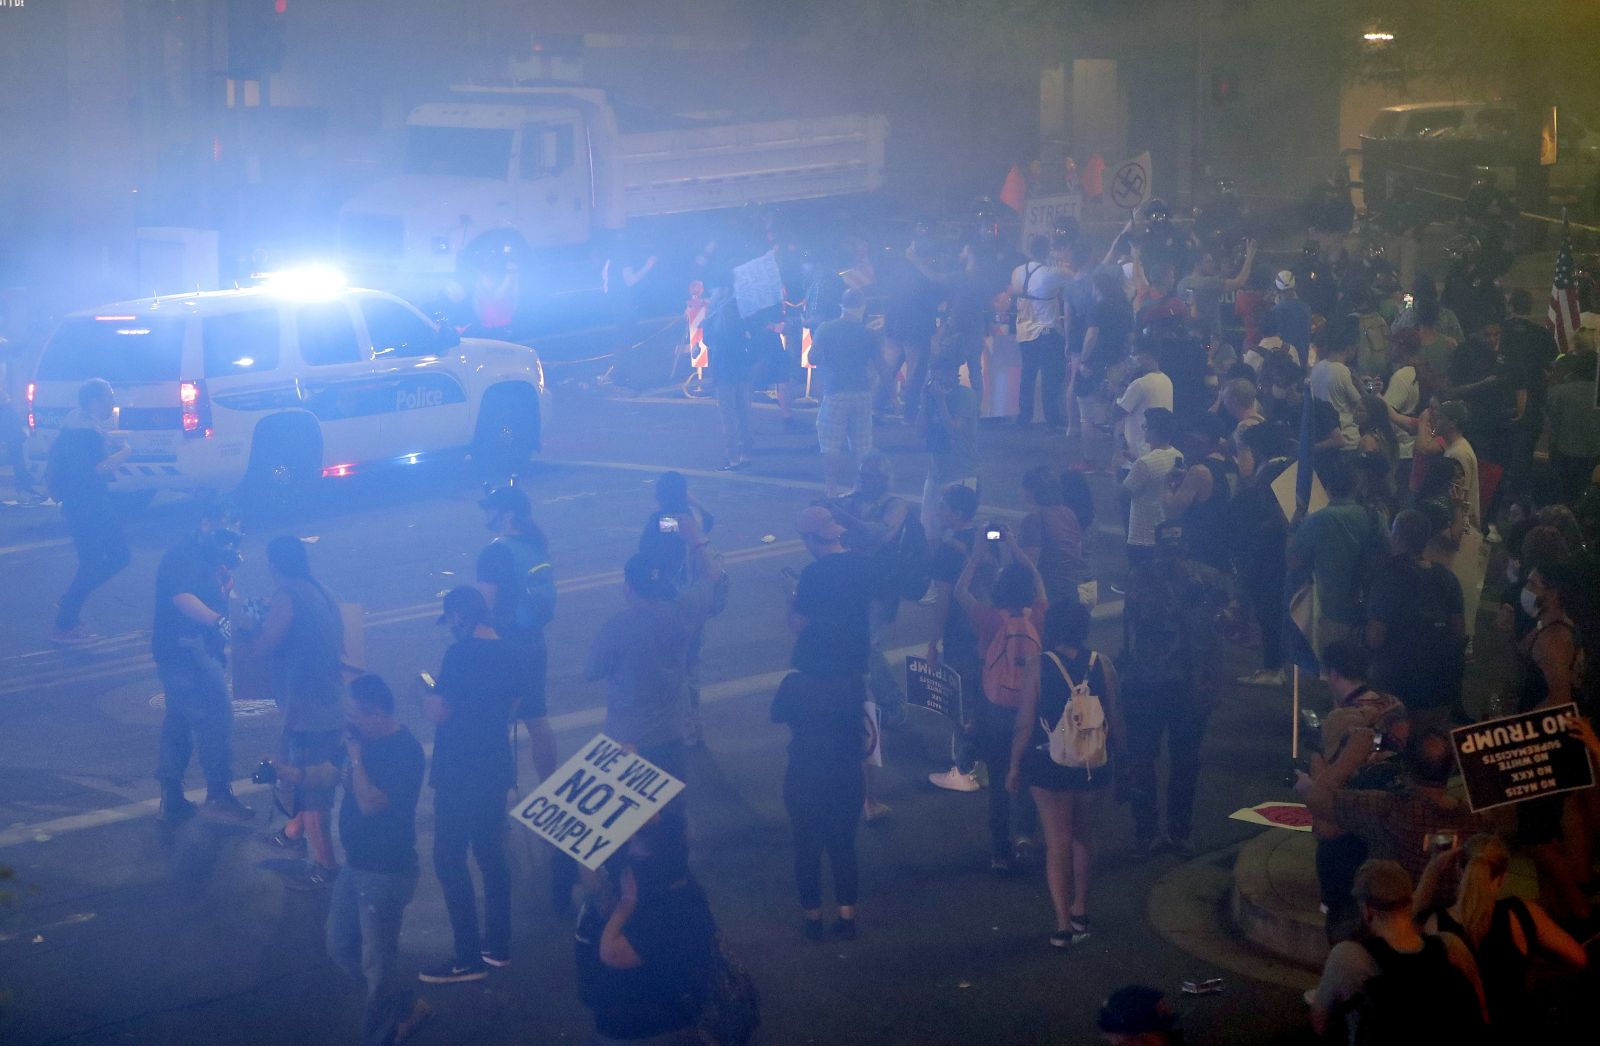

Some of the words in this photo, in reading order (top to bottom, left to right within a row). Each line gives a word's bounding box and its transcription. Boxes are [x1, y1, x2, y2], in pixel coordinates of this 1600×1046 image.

[396, 386, 443, 410] Police
[1541, 711, 1574, 735] NO
[1461, 720, 1540, 754] TRUMP
[1481, 739, 1562, 765] SUPREMACISTS
[1533, 752, 1549, 763] NO
[584, 739, 627, 773] WE
[617, 759, 670, 803] WILL
[1498, 758, 1533, 771] WHITE
[1511, 769, 1534, 782] KKK
[1537, 765, 1553, 776] NO
[1505, 782, 1538, 798] NAZIS
[1540, 778, 1557, 789] NO
[554, 768, 640, 829] NOT
[521, 796, 611, 861] COMPLY
